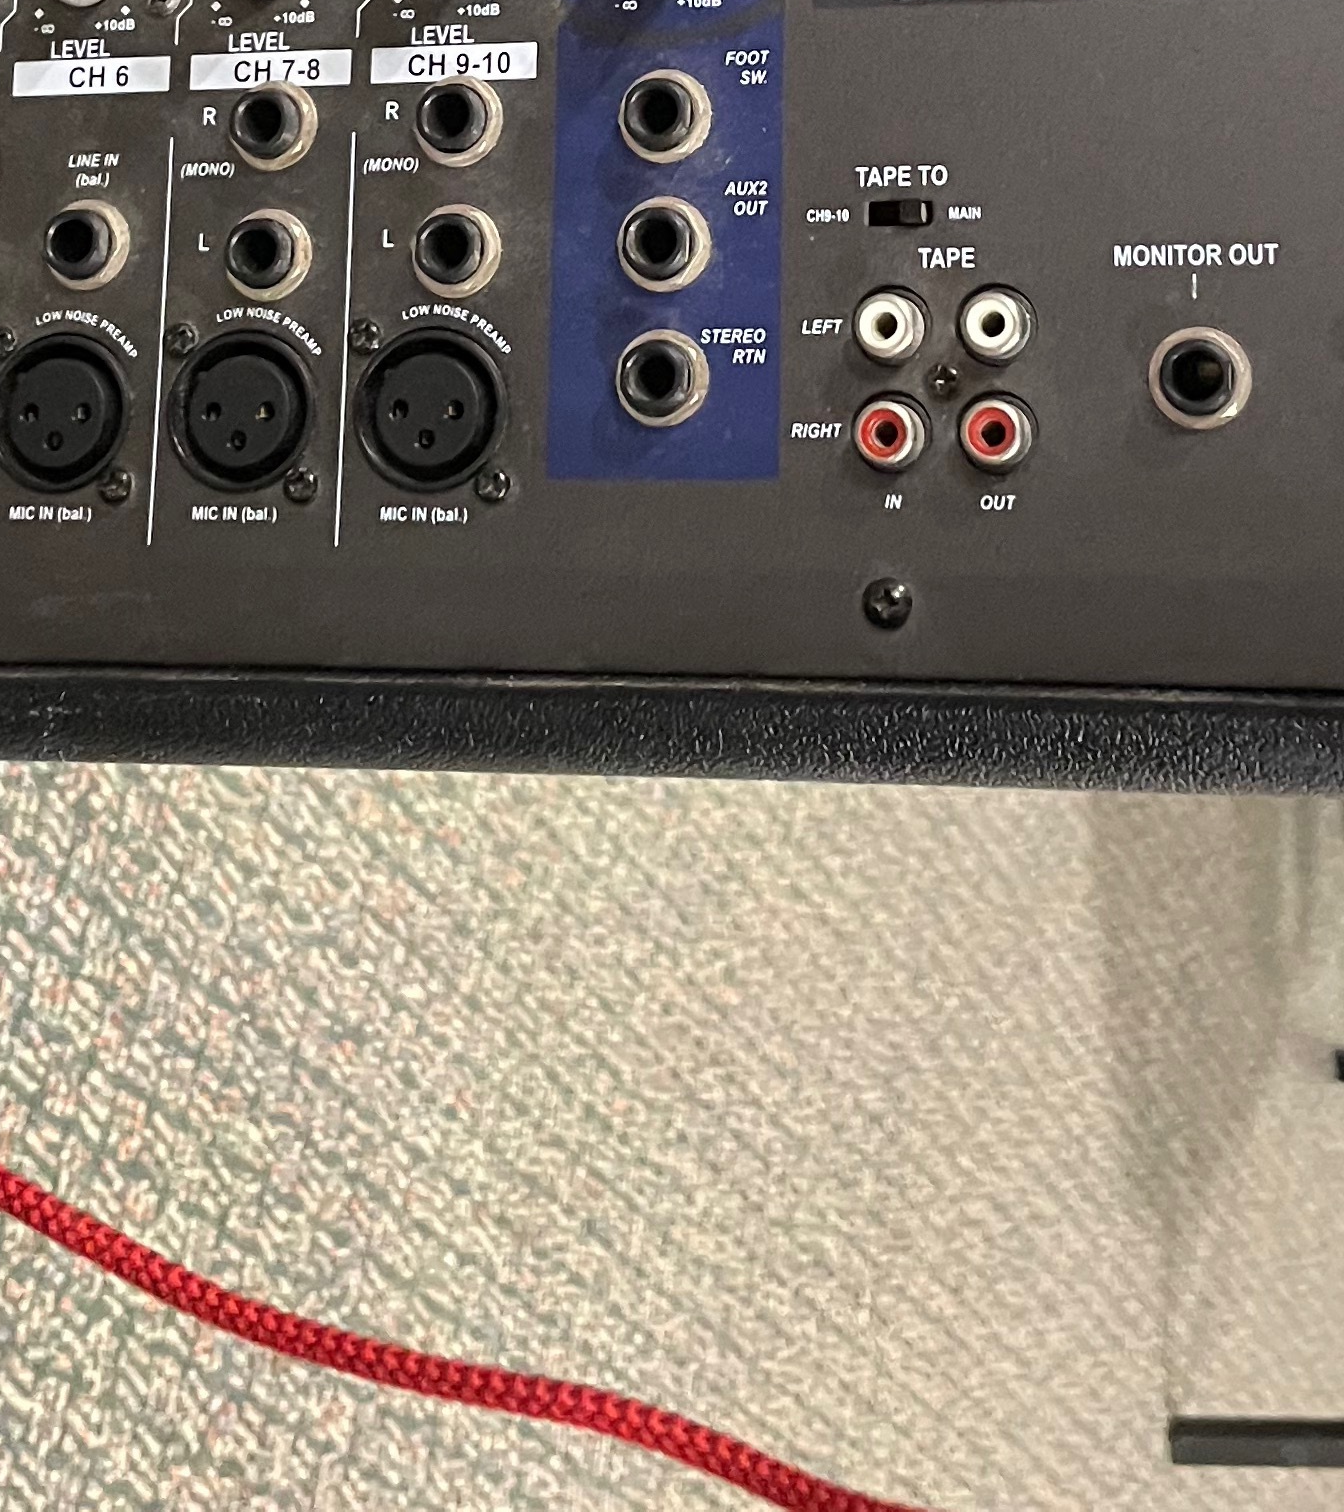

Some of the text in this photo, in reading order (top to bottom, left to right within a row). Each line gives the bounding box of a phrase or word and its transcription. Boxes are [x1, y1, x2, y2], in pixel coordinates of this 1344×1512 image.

[229, 32, 290, 52] LEVEL
[412, 25, 474, 44] LEVEL
[51, 39, 110, 58] LEVEL
[409, 52, 510, 76] CH 9-10
[726, 50, 769, 65] FOOT
[70, 66, 128, 87] CH 6
[235, 59, 319, 87] CH 7-8
[740, 70, 767, 84] SW.
[386, 101, 399, 119] R
[69, 154, 119, 167] LINE IN
[364, 157, 418, 174] (MONO)
[855, 165, 947, 187] TAPE TO
[725, 181, 767, 196] AUX2
[734, 200, 768, 215] OUT
[807, 209, 849, 222] CH9-10
[949, 207, 981, 219] MAIN
[383, 229, 394, 247] L
[918, 247, 975, 268] TAPE
[1114, 243, 1278, 266] MONITOR OUT
[402, 304, 511, 353] LOW NOISE PREAMP
[802, 319, 843, 334] LEFT
[701, 328, 766, 343] STEREO
[733, 349, 766, 363] RTN
[792, 423, 842, 438] RIGHT
[885, 495, 902, 509] IN
[981, 495, 1015, 510] OUT
[380, 507, 467, 524] MIC IN (bal.)
